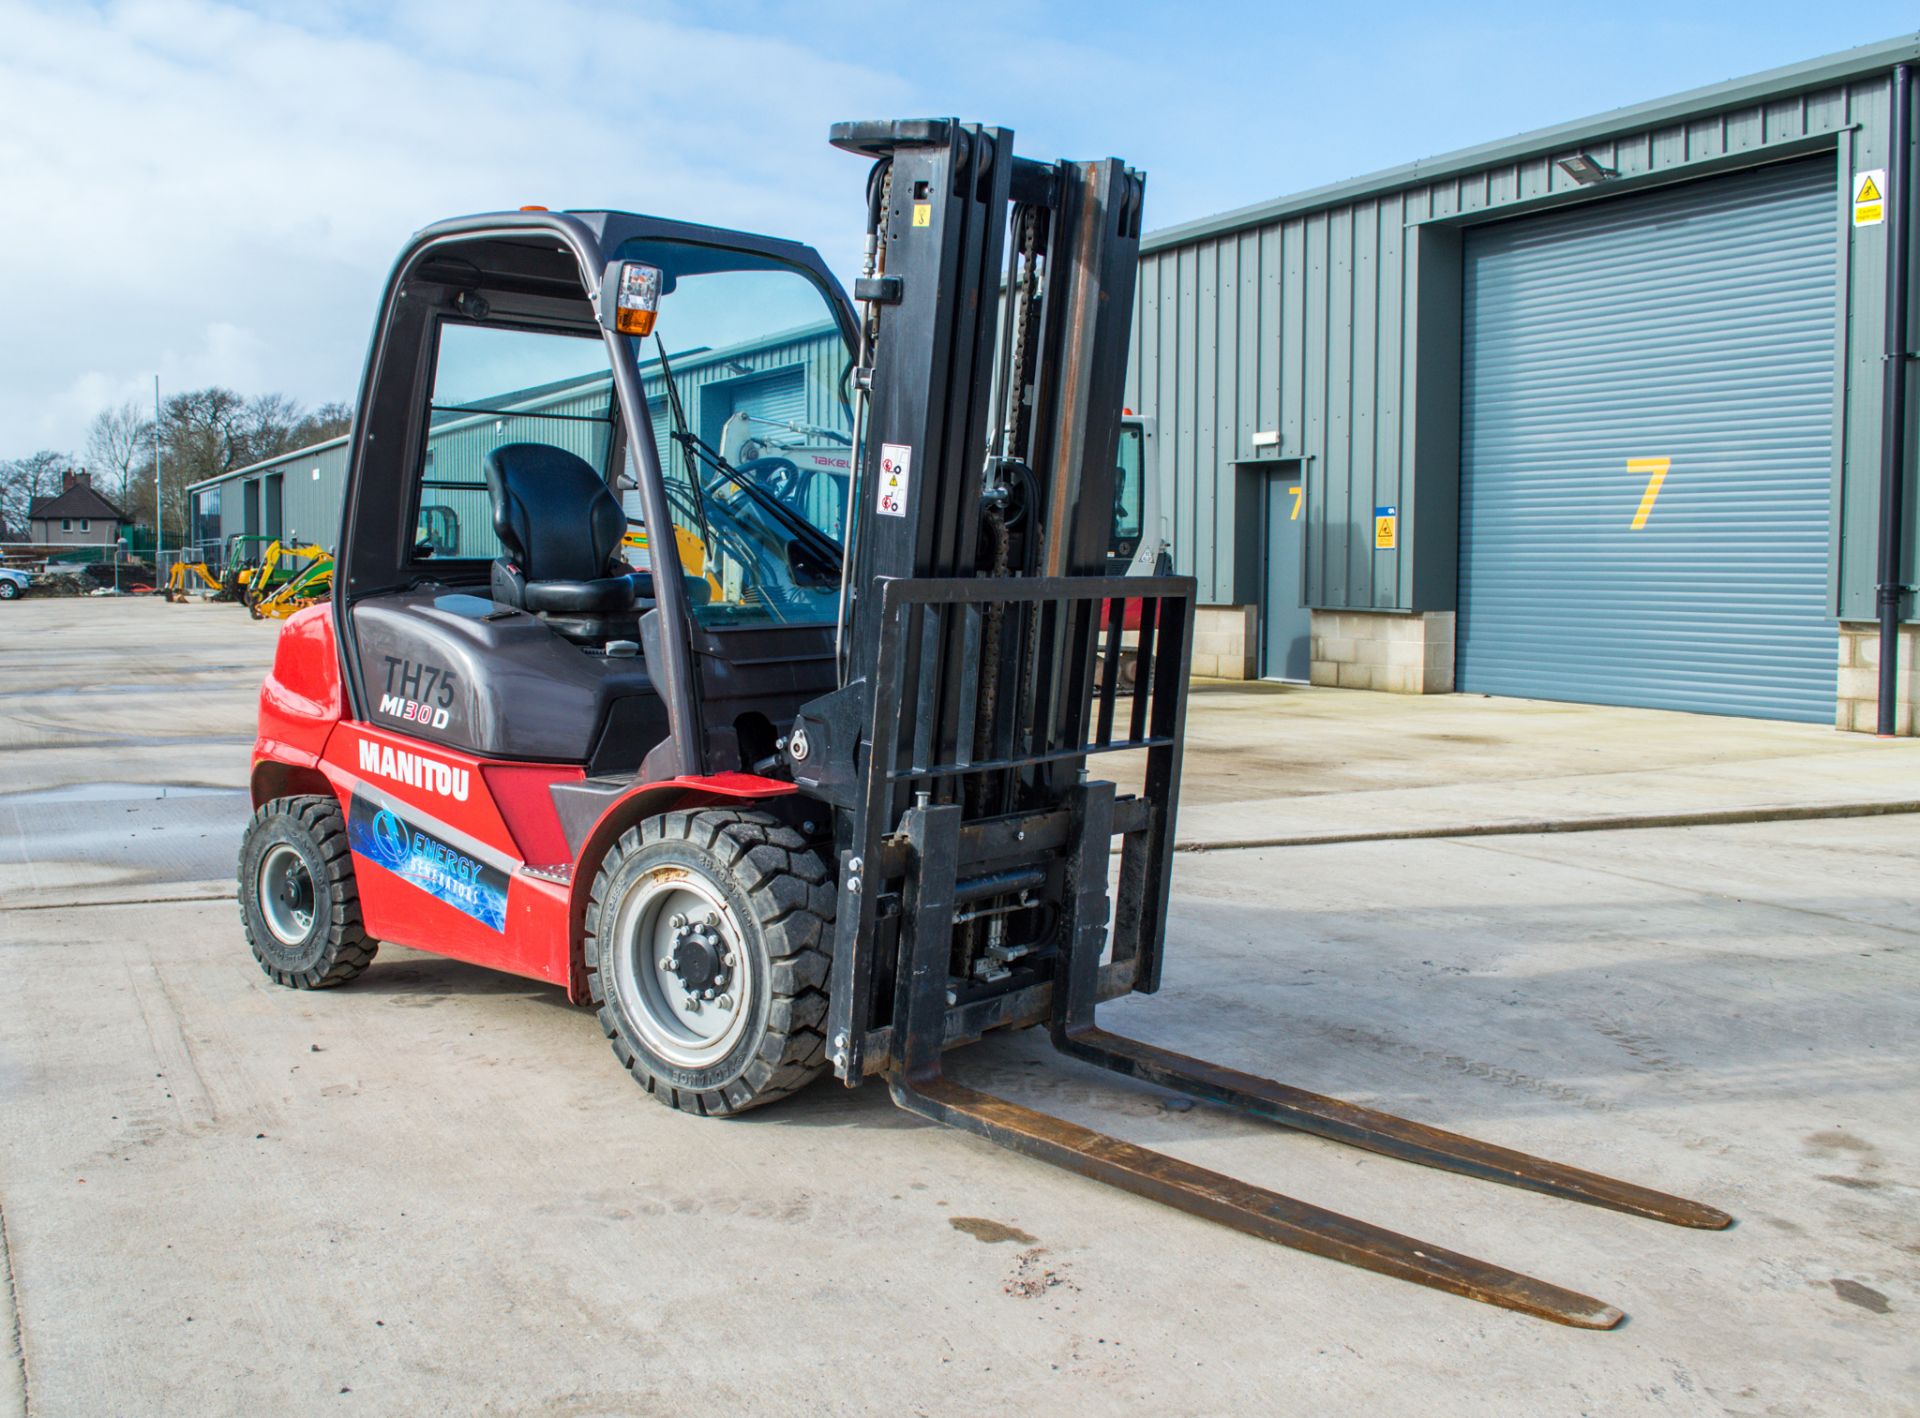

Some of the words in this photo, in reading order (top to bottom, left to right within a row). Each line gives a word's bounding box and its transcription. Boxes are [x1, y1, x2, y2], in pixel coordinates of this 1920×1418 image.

[1288, 486, 1302, 521] 7
[1626, 457, 1671, 530] 7
[385, 655, 457, 708] TH75
[358, 739, 469, 802] MANITOU
[413, 833, 483, 884] ENERGY
